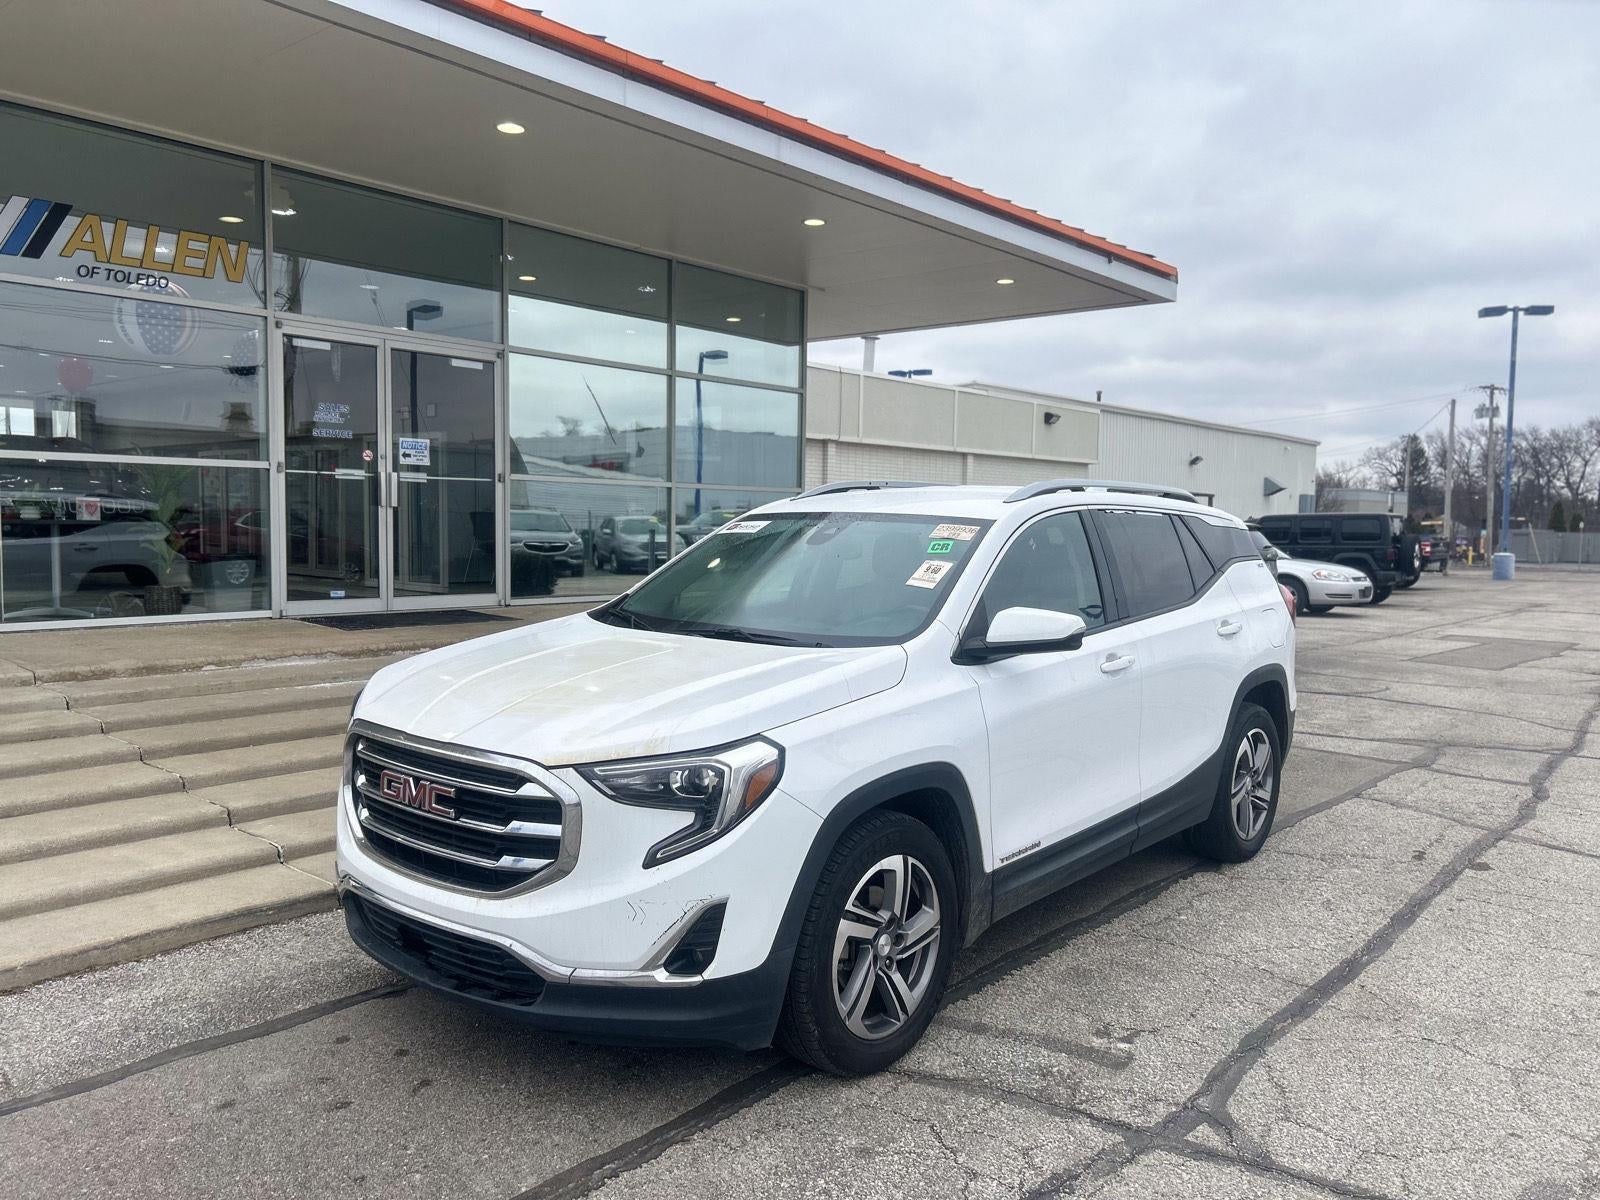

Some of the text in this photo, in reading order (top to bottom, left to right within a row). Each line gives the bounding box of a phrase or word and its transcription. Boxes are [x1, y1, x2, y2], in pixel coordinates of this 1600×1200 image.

[60, 214, 249, 283] ALLEN
[77, 264, 169, 289] OF TOLEDO
[318, 402, 349, 414] SALES
[312, 428, 353, 439] SERVICE
[401, 441, 427, 450] NOTICE
[930, 542, 951, 551] CR
[380, 770, 456, 819] GMC
